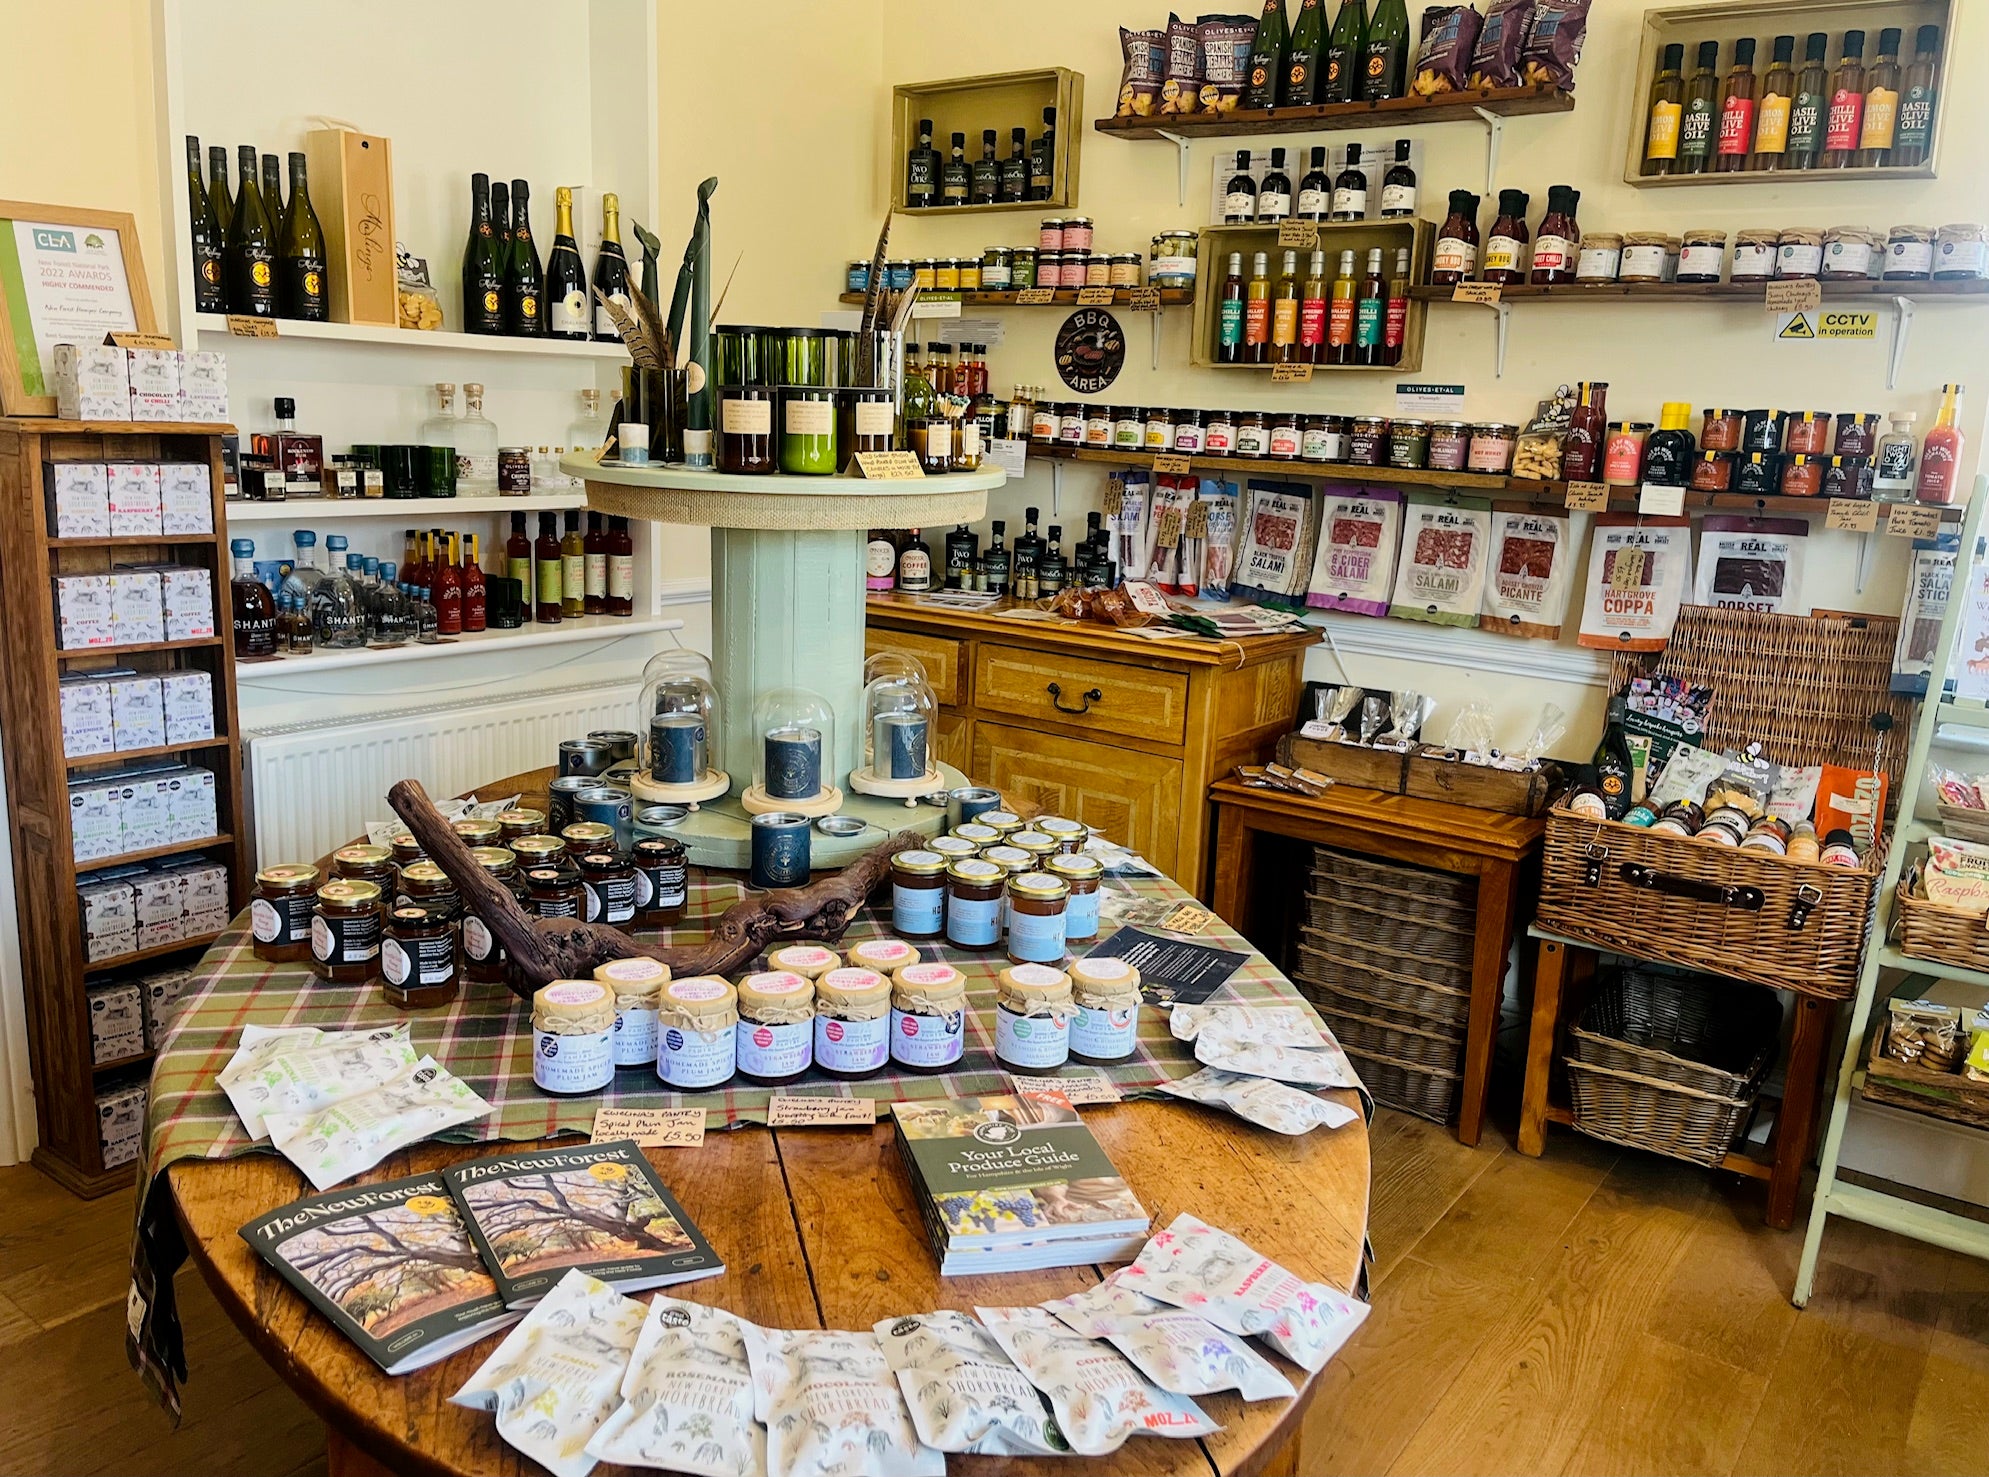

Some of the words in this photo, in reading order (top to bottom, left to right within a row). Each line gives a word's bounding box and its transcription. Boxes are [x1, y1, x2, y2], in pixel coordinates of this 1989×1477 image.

[1171, 36, 1196, 52] SPANISH
[1205, 41, 1232, 55] SPANISH
[1206, 68, 1232, 81] CRACKERS
[1902, 102, 1930, 111] BASIL
[1686, 113, 1710, 122] BASIL
[1901, 111, 1929, 121] OLIVE
[1684, 122, 1710, 132] OLIVE
[1828, 123, 1849, 132] OIL
[1864, 120, 1885, 130] OIL
[1902, 120, 1925, 129] OIL
[1685, 130, 1705, 140] OIL
[1720, 129, 1738, 138] OIL
[1759, 127, 1778, 135] OIL
[1791, 125, 1812, 135] OIL
[912, 165, 927, 174] Two
[911, 173, 928, 183] One
[37, 232, 71, 249] CLA
[40, 267, 64, 278] 2022
[68, 269, 112, 281] AWARDS
[68, 283, 114, 292] COMMENDED
[1074, 312, 1110, 329] BBQ
[1826, 315, 1869, 325] CCTV
[1818, 327, 1827, 335] in
[1830, 327, 1873, 336] operation
[1070, 376, 1107, 390] AREA
[1271, 500, 1286, 510] REAL
[1351, 505, 1369, 515] REAL
[1438, 514, 1459, 525] REAL
[1909, 518, 1931, 526] Tomato
[1523, 522, 1543, 532] REAL
[1741, 542, 1767, 552] REAL
[953, 550, 970, 559] Two
[1017, 554, 1033, 564] Two
[1250, 557, 1285, 573] SALAMI
[1332, 555, 1338, 564] &
[1341, 555, 1370, 568] CIDER
[1330, 565, 1369, 580] SALAMI
[1416, 575, 1460, 591] SALAMI
[1500, 587, 1543, 602] PICANTE
[1604, 590, 1656, 600] HARTGROVE
[1604, 599, 1654, 615] COPPA
[1718, 600, 1774, 613] DORSET
[327, 615, 365, 625] SHANTY
[191, 906, 223, 916] CHOCOLATE
[145, 917, 178, 927] CHOCOLATE
[96, 928, 130, 940] CHOCOLATE
[103, 1031, 136, 1041] ROSEMARY
[665, 1058, 709, 1068] HOMEMADE
[540, 1065, 584, 1074] HOMEMADE
[706, 1066, 721, 1075] JAM
[582, 1072, 598, 1081] JAM
[1036, 1093, 1066, 1105] FREE
[776, 1104, 831, 1113] Strawberry
[600, 1120, 630, 1130] Spiced
[636, 1119, 661, 1128] Plum
[667, 1119, 696, 1128] Jam
[595, 1130, 628, 1138] Locally
[663, 1132, 702, 1143] £5.50
[960, 1149, 1004, 1162] Your
[1006, 1142, 1055, 1157] Local
[947, 1158, 1022, 1174] Produce
[1025, 1151, 1080, 1165] Guide
[978, 1170, 1014, 1178] Hampshire
[1234, 1261, 1272, 1296] RASPBERRY
[661, 1313, 689, 1327] taste
[1143, 1315, 1201, 1329] LAVENDER
[551, 1353, 600, 1370] LEMON
[535, 1357, 560, 1370] NEW
[563, 1362, 598, 1382] FOREST
[1078, 1365, 1100, 1378] NEW
[665, 1371, 748, 1387] ROSEMARY
[956, 1368, 977, 1379] NEW
[984, 1370, 1020, 1382] FOREST
[667, 1380, 694, 1390] NEW
[947, 1379, 1036, 1398] SHORTBREAD
[804, 1391, 830, 1400] NEW
[834, 1389, 874, 1399] FOREST
[653, 1390, 741, 1419] SHORTBREAD
[800, 1398, 890, 1425] SHORTBREAD
